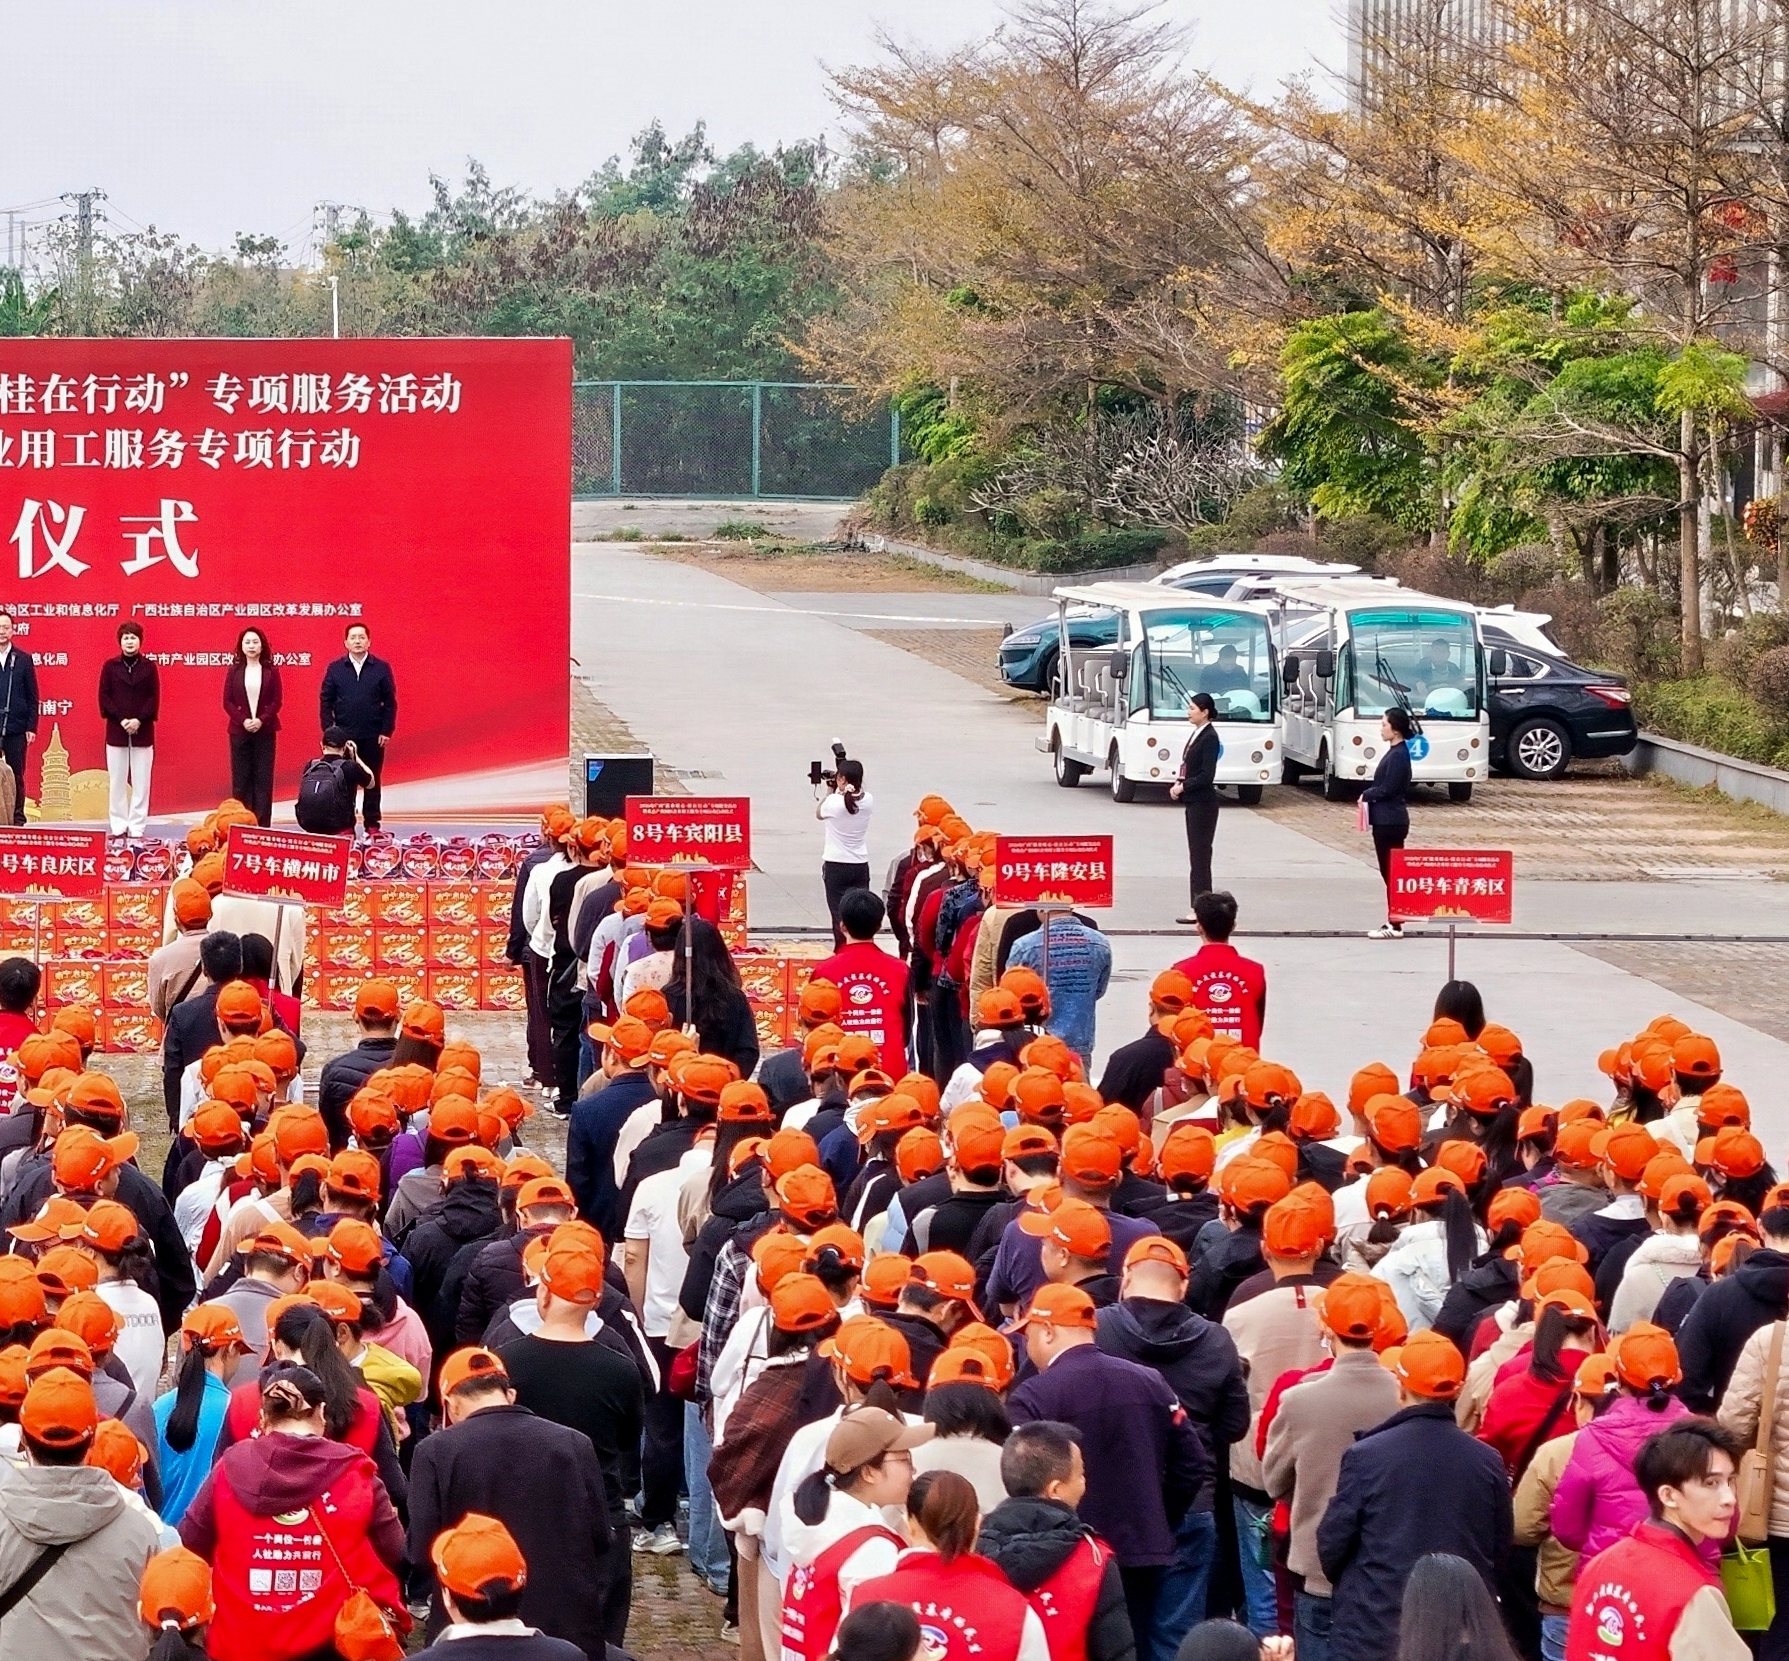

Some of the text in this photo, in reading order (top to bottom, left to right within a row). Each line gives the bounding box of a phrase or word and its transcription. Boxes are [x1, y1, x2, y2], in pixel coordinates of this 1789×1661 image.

[131, 602, 363, 617] 广西壮族自治区产业园区改革发展办公室
[142, 652, 312, 667] 宁市产业园区改办公室
[39, 699, 74, 715] 南宁
[1409, 738, 1422, 757] 4
[632, 822, 743, 844] 8号车宾阳县
[231, 852, 341, 883] 7号车横州市
[1001, 861, 1106, 882] 9号车隆安县
[1397, 876, 1505, 896] 10号车青秀区
